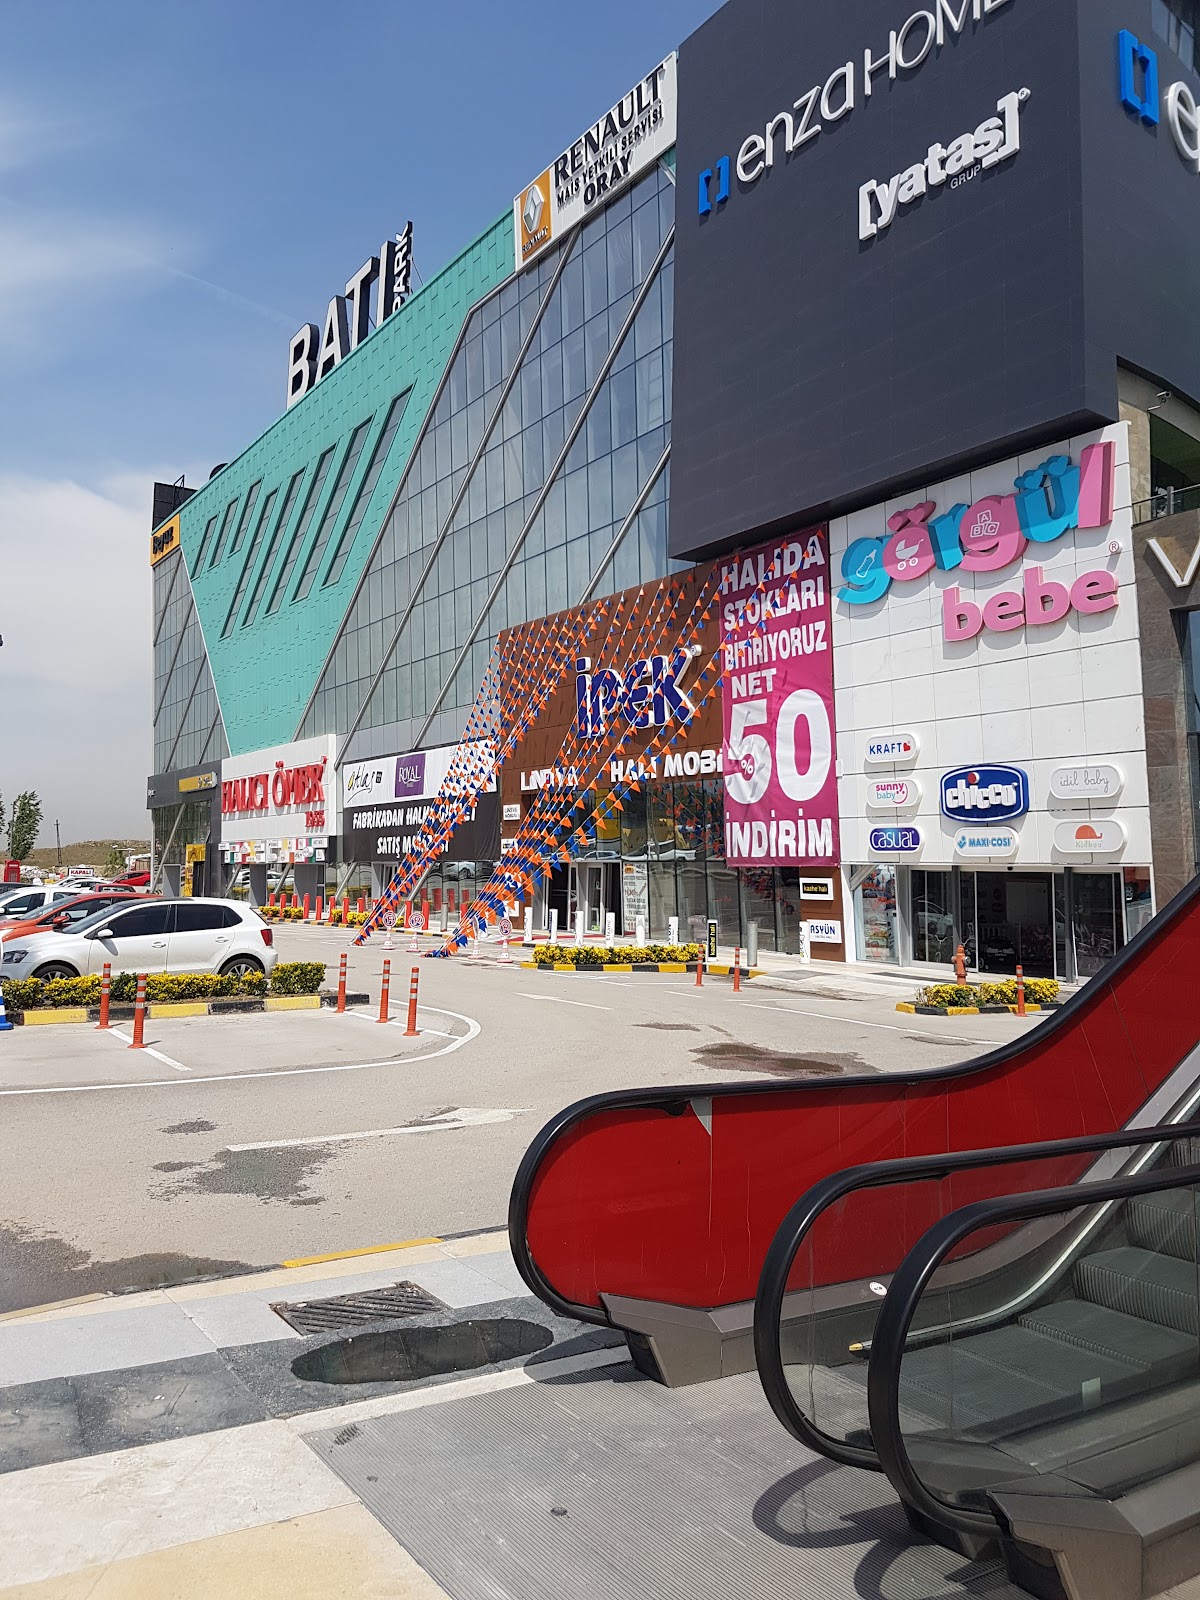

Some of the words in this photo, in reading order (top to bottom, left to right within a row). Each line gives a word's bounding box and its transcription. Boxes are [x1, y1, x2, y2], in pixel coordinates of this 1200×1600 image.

[737, 61, 854, 182] enza
[864, 0, 1010, 96] HOM
[554, 63, 665, 189] RENAULT
[583, 150, 633, 206] ORAY
[950, 164, 982, 190] GRUP
[837, 440, 1116, 605] görgül
[721, 534, 826, 595] HALIDA
[724, 576, 825, 631] STOKLARI
[942, 566, 1119, 642] bebe
[731, 668, 776, 698] NET
[724, 688, 832, 805] 50
[869, 743, 902, 755] KRAFT
[272, 761, 325, 808] ÖMER
[398, 765, 421, 784] ROYAL
[875, 782, 905, 793] sunny
[876, 791, 896, 800] baby
[945, 772, 1017, 809] chicco
[1084, 769, 1109, 793] baby
[352, 807, 404, 829] FABRİKADAN
[725, 808, 833, 858] İNDİRİM
[377, 836, 401, 858] SATIŞ
